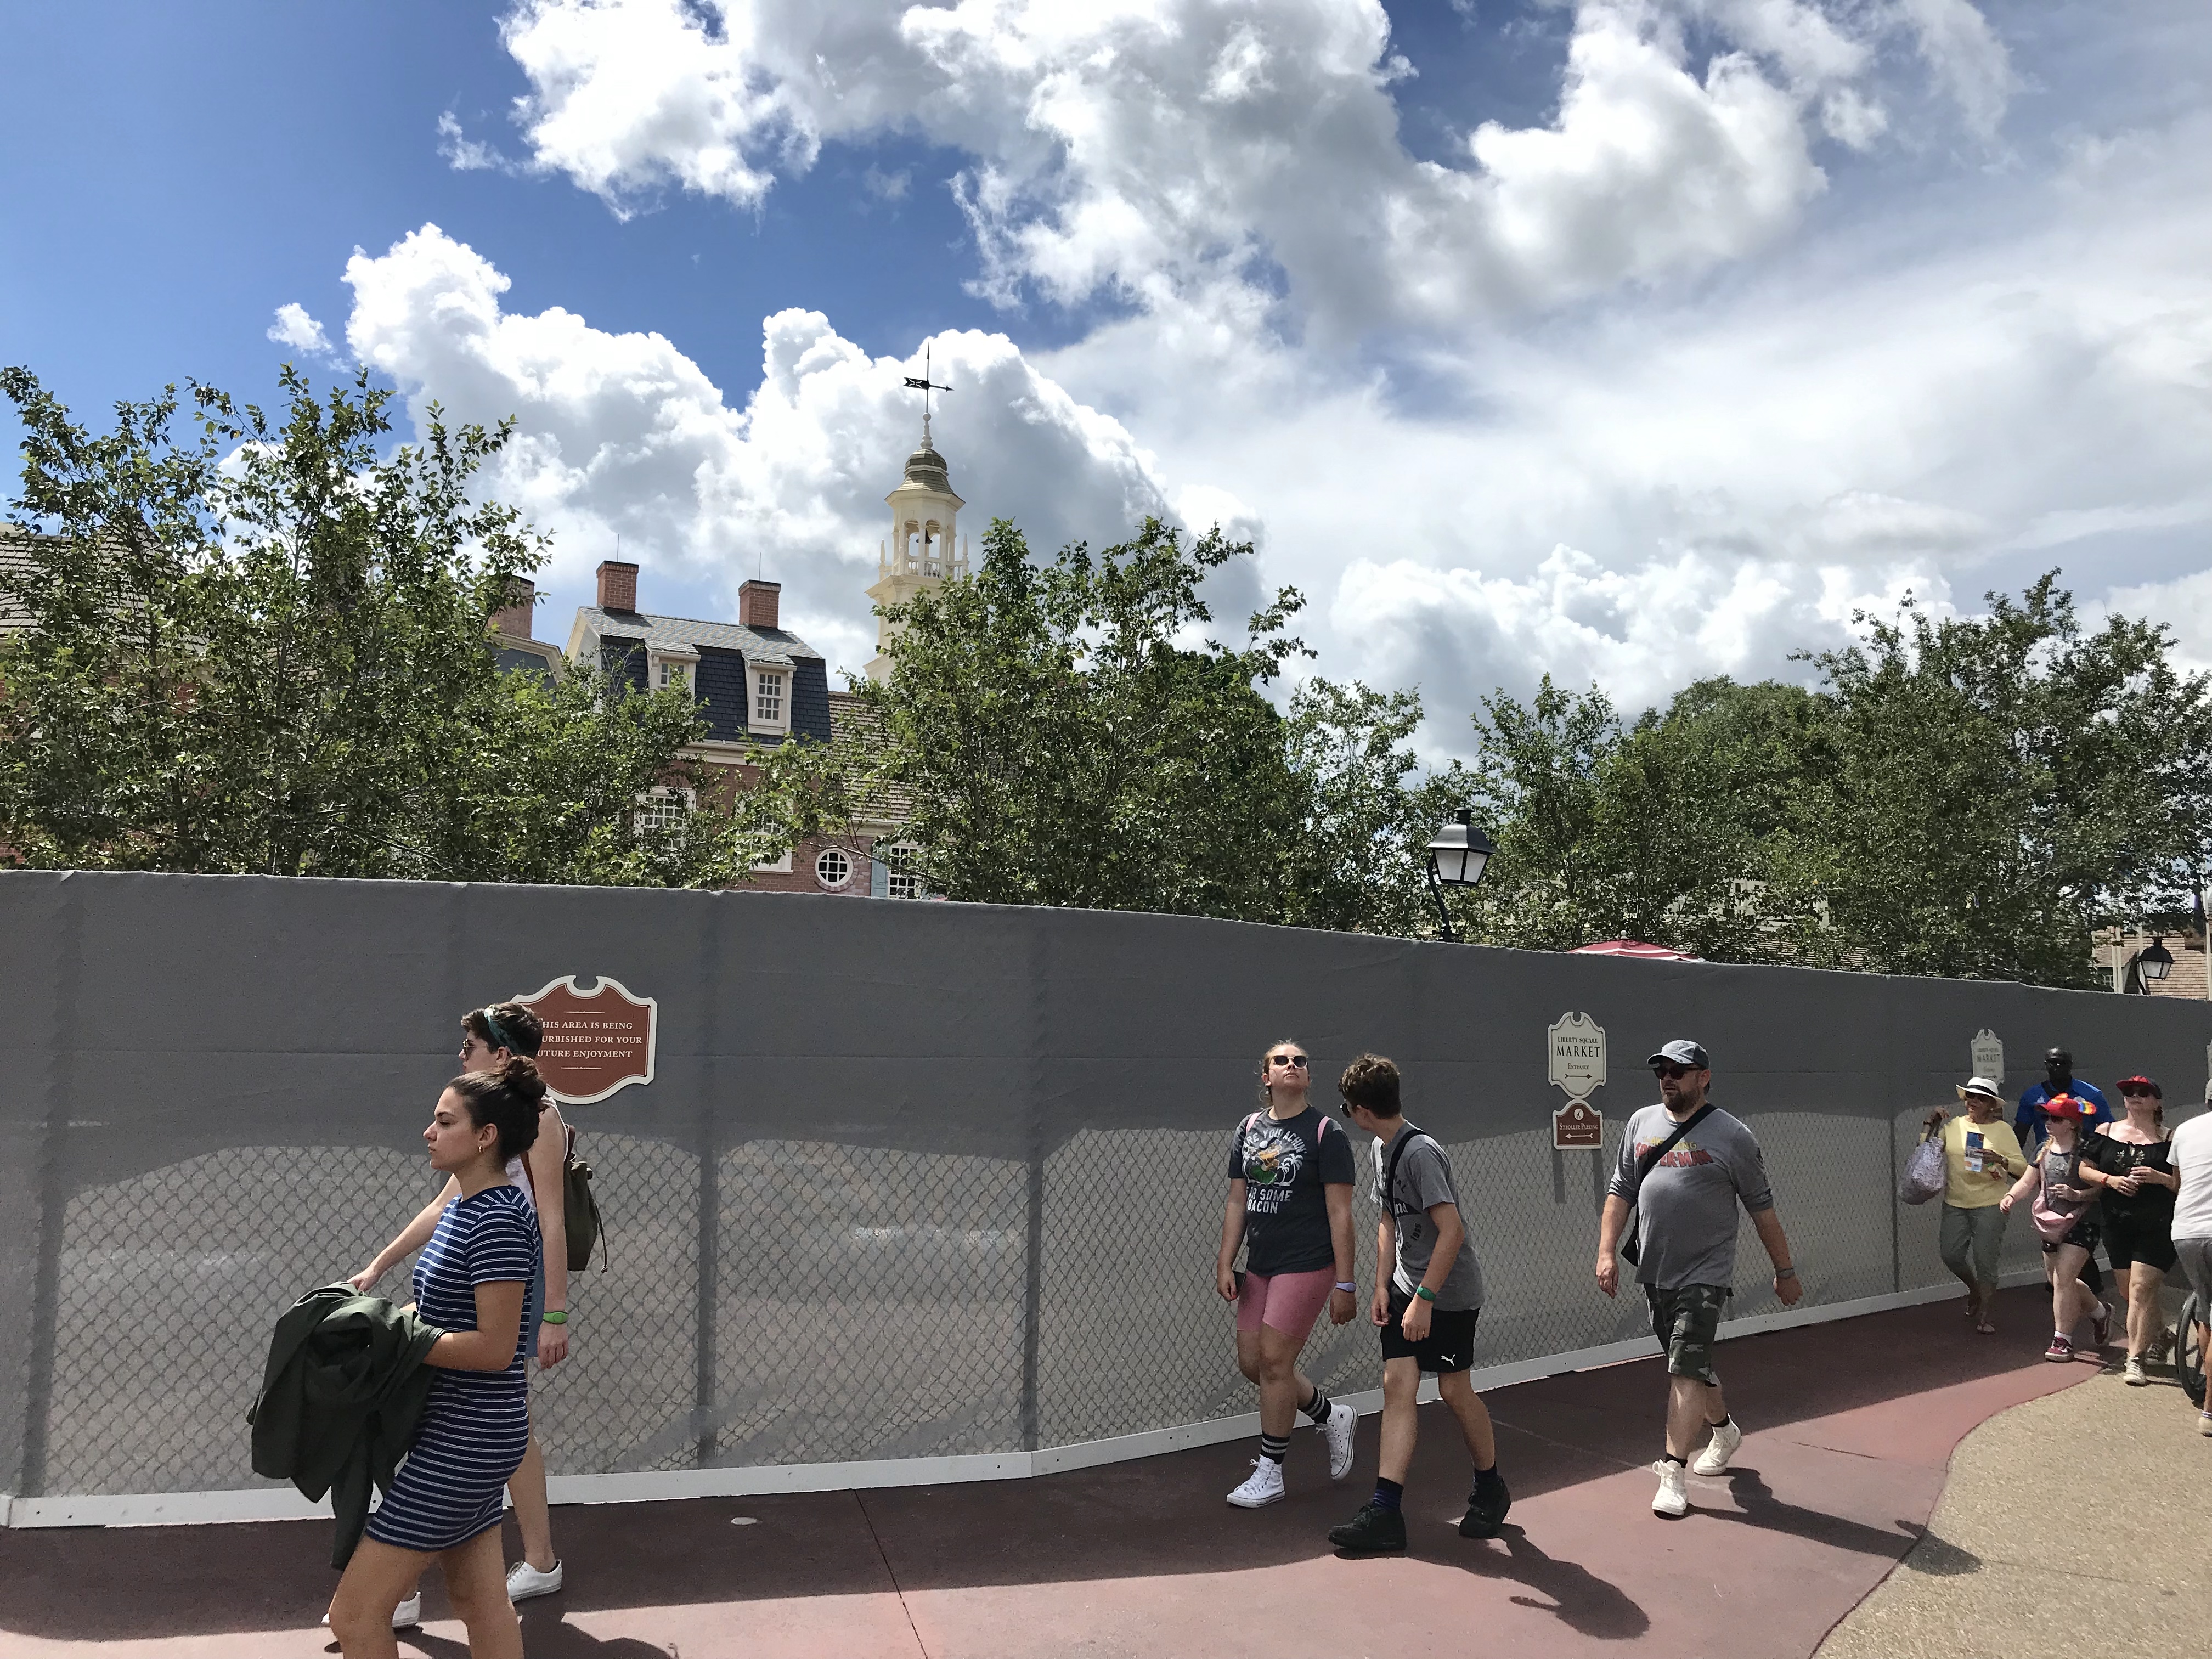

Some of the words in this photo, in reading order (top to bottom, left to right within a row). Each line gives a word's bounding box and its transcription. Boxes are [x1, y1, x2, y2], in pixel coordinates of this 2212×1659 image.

[573, 1050, 633, 1059] ENJOYMENT
[1556, 1045, 1600, 1057] MARKET
[1263, 1128, 1283, 1139] YOU
[1635, 1142, 1714, 1168] SPER-MAN
[1260, 1188, 1293, 1201] SOME
[1247, 1198, 1279, 1214] BACON
